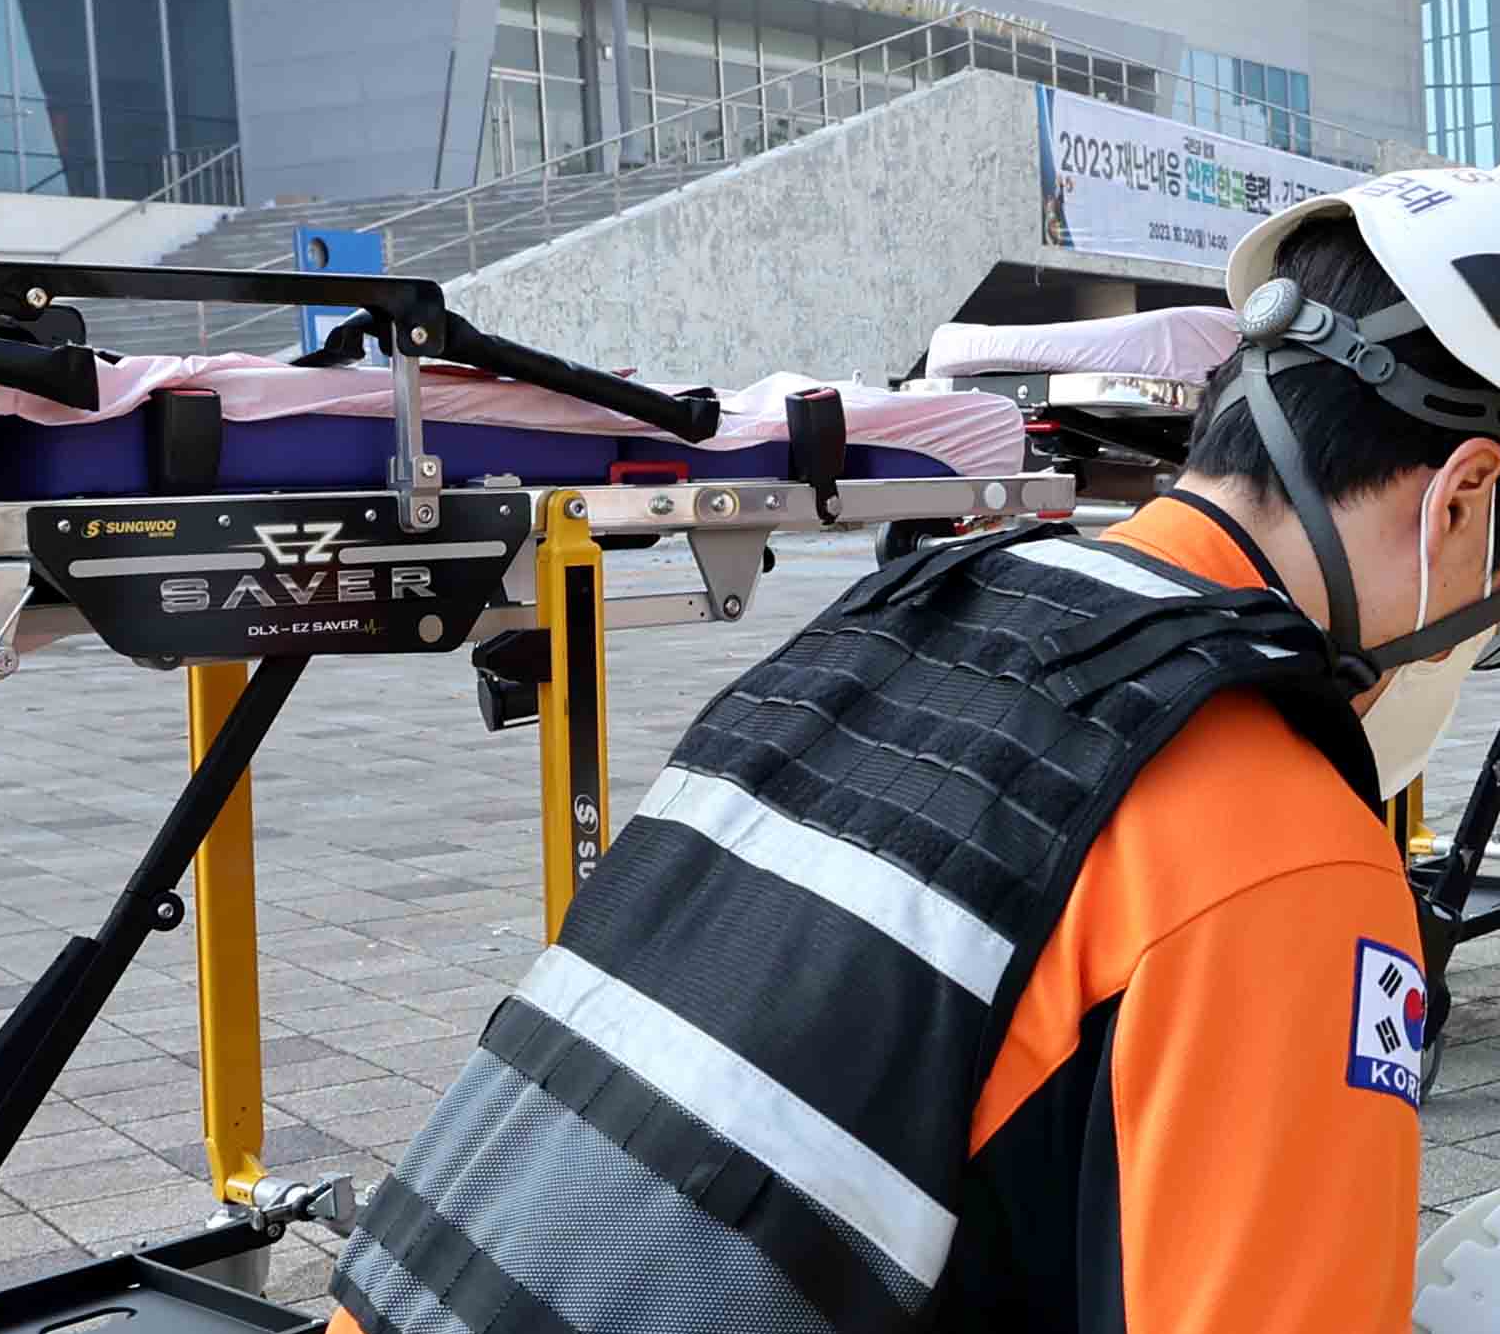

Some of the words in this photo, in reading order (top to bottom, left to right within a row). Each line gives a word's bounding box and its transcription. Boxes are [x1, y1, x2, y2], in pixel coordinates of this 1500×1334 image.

[105, 519, 178, 534] SUNGWOO
[160, 567, 436, 614] SAVER
[312, 619, 359, 632] SAVER
